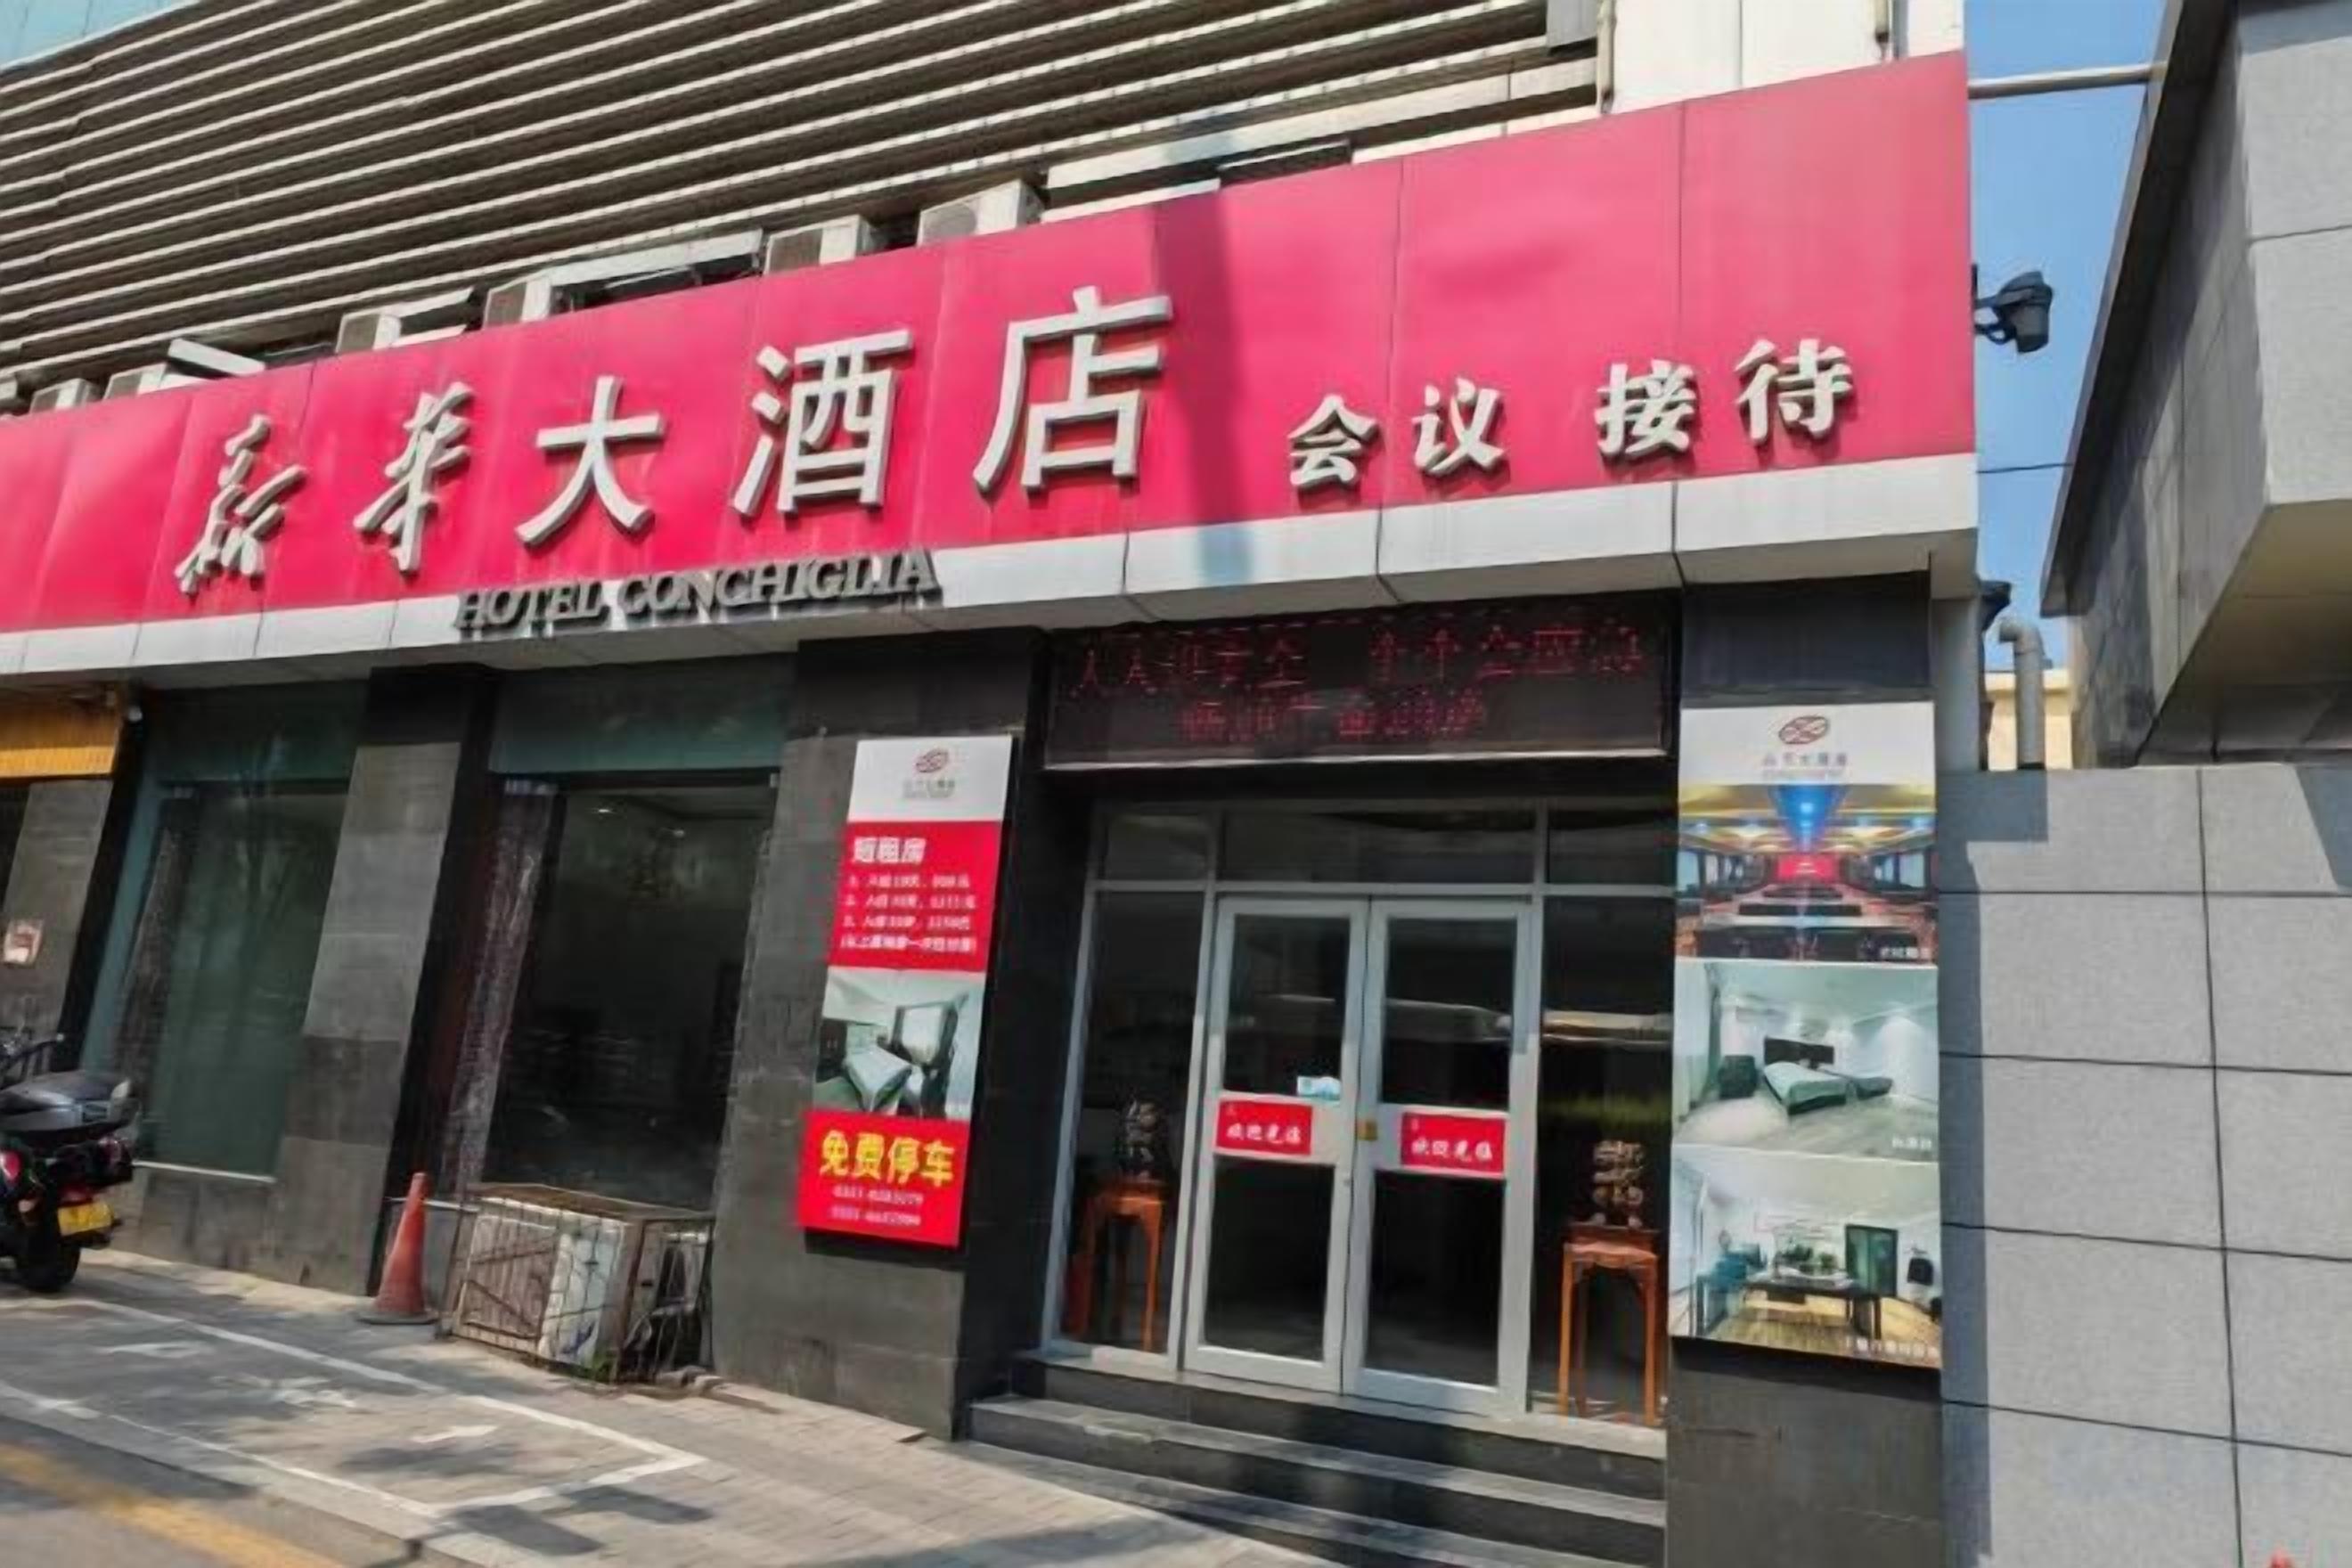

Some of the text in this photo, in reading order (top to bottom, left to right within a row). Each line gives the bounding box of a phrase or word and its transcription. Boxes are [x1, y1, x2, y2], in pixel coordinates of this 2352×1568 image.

[1288, 338, 1854, 490] 会议 接待
[453, 550, 940, 629] HOTEL CONCHIGLIA
[820, 1130, 955, 1187] 免费停车
